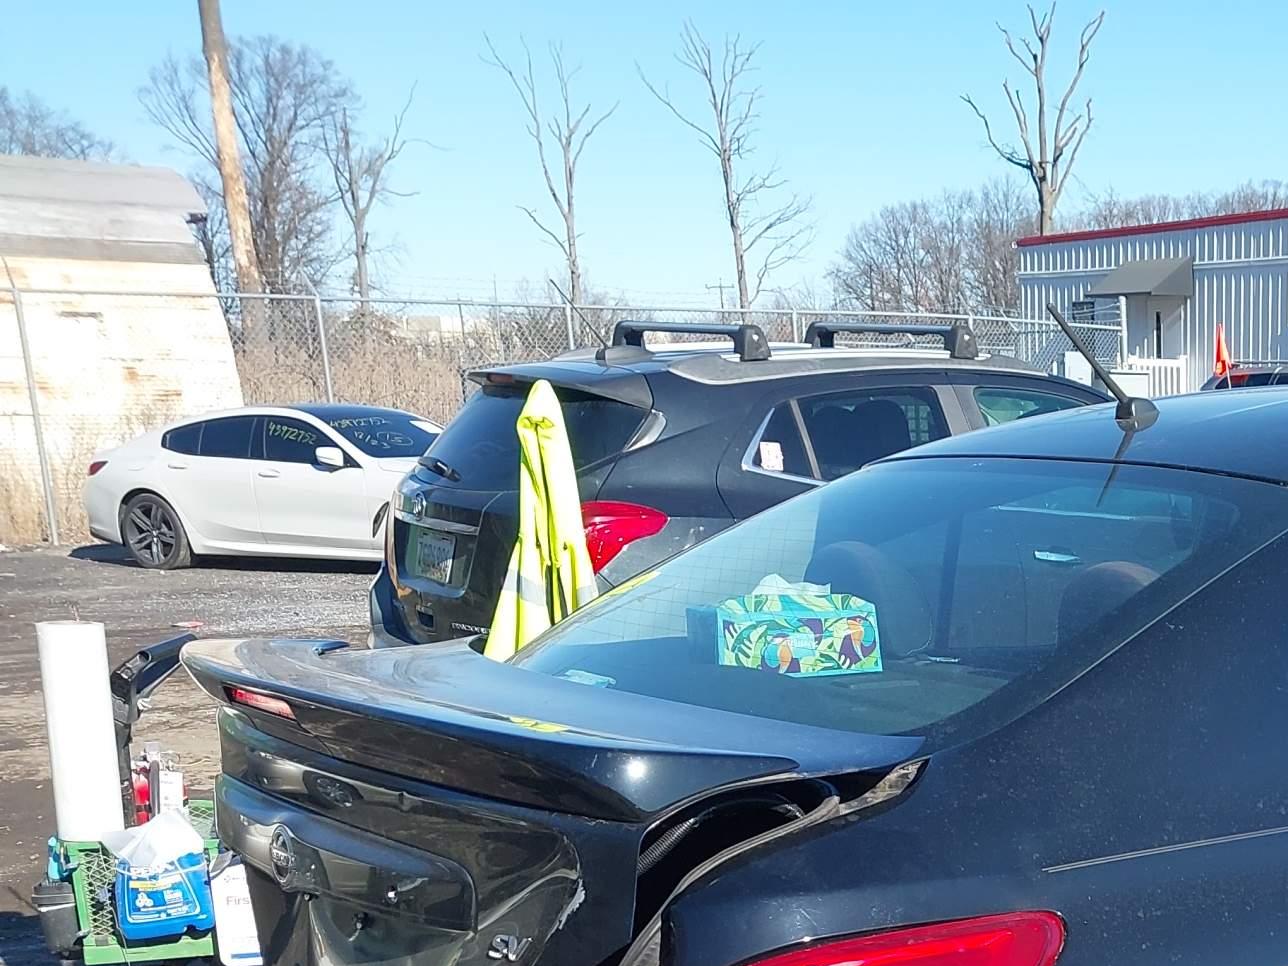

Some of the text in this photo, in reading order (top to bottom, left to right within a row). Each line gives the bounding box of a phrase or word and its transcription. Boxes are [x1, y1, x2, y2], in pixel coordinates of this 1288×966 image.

[268, 421, 317, 446] 43972752
[226, 895, 251, 906] Firs
[488, 934, 533, 961] SV
